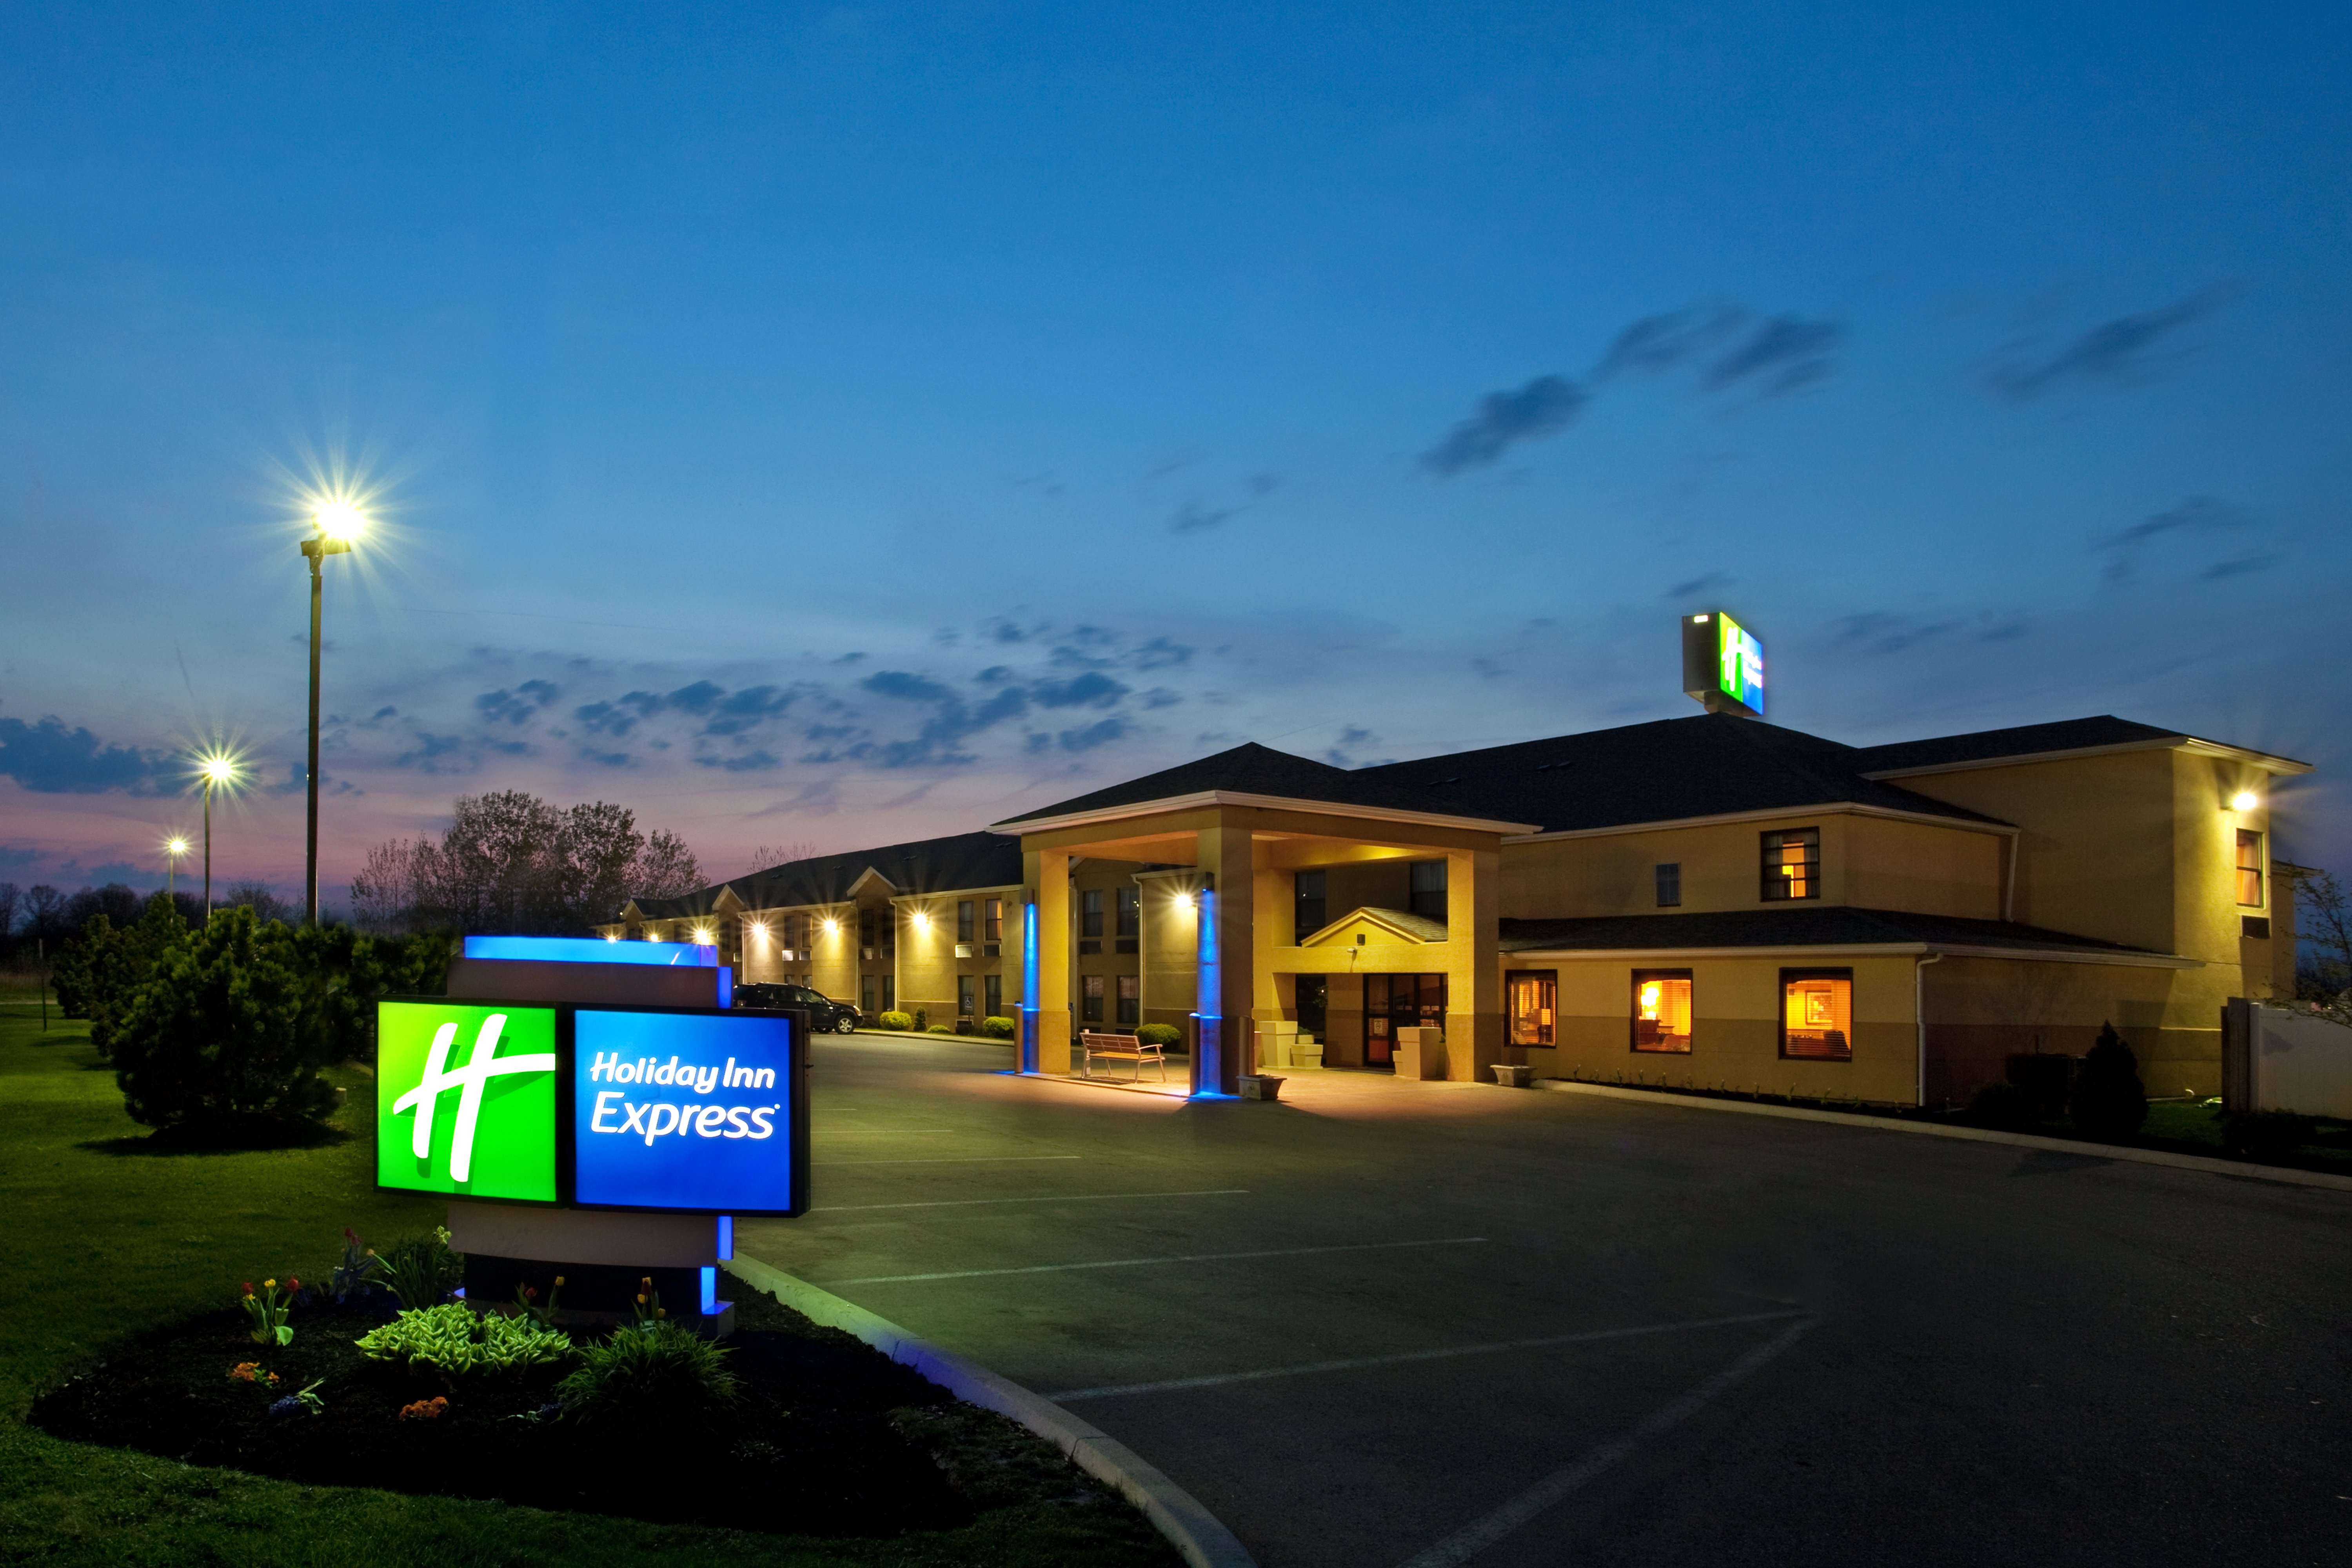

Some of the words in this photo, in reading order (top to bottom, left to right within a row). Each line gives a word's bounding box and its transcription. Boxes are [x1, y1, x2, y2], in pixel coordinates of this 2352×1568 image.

[392, 1013, 556, 1182] H
[590, 1051, 719, 1094] Holiday
[723, 1057, 776, 1089] Inn
[590, 1091, 776, 1147] Express
